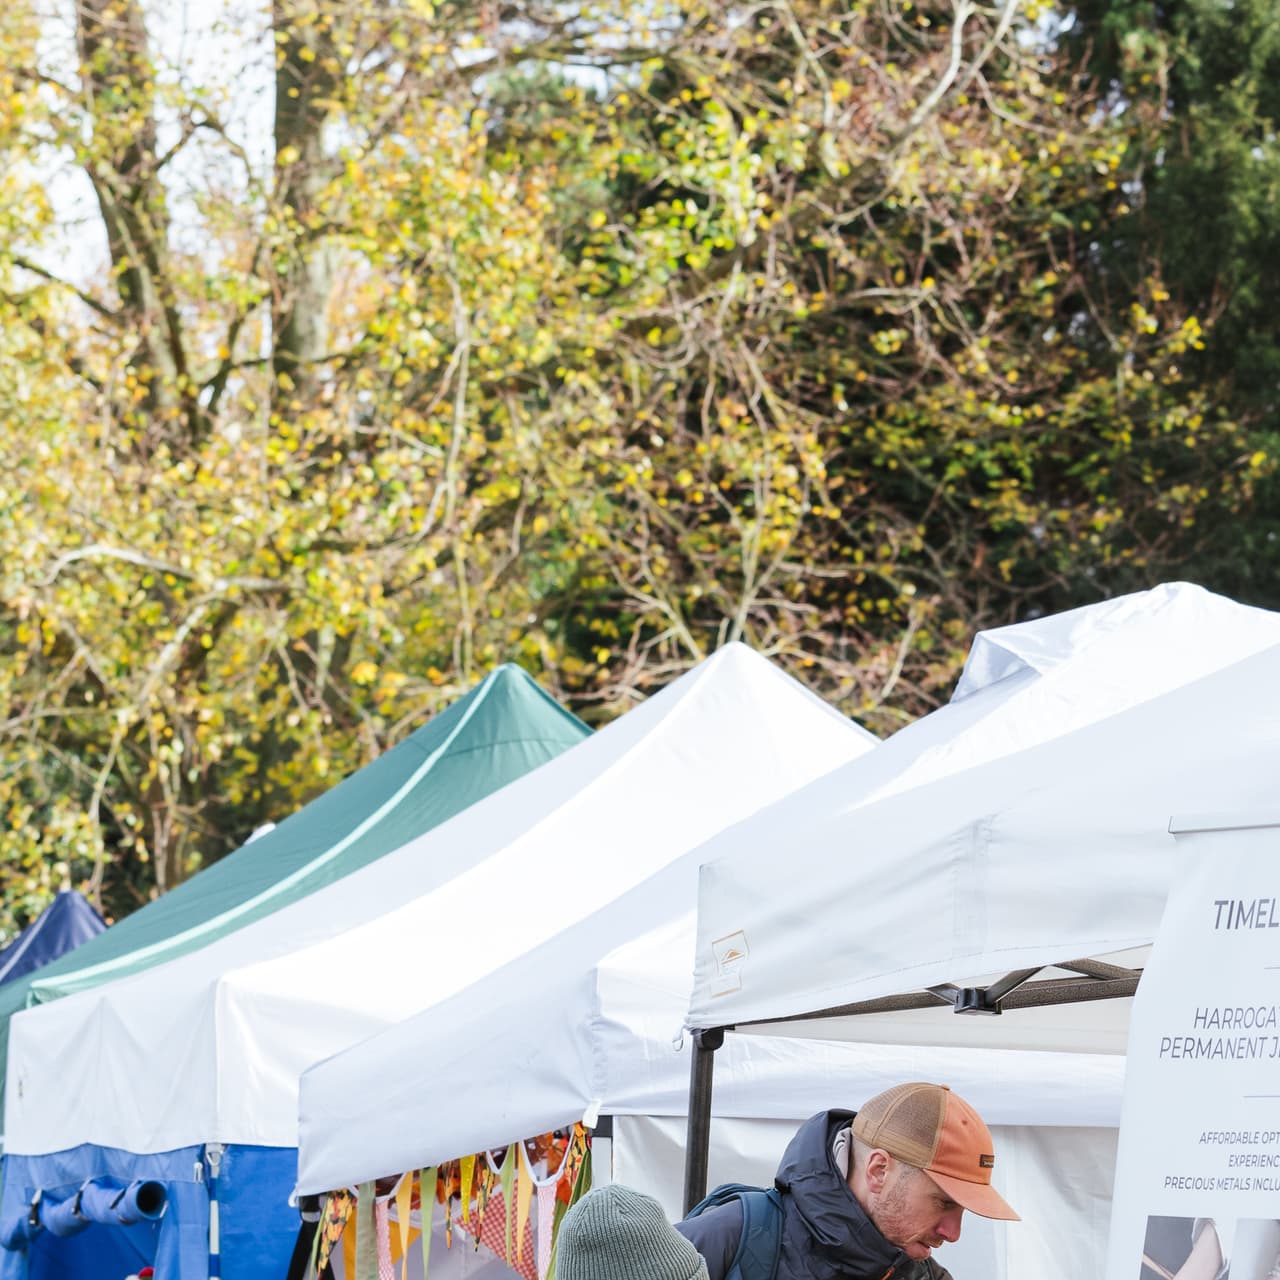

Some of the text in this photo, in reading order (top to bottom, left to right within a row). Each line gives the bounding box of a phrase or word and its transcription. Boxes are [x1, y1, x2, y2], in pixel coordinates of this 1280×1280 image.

[1159, 1036, 1268, 1059] PERMANENT
[1198, 1131, 1260, 1144] AFFORDABLE
[1163, 1175, 1215, 1190] PRECIOUS
[1216, 1177, 1251, 1190] METALS
